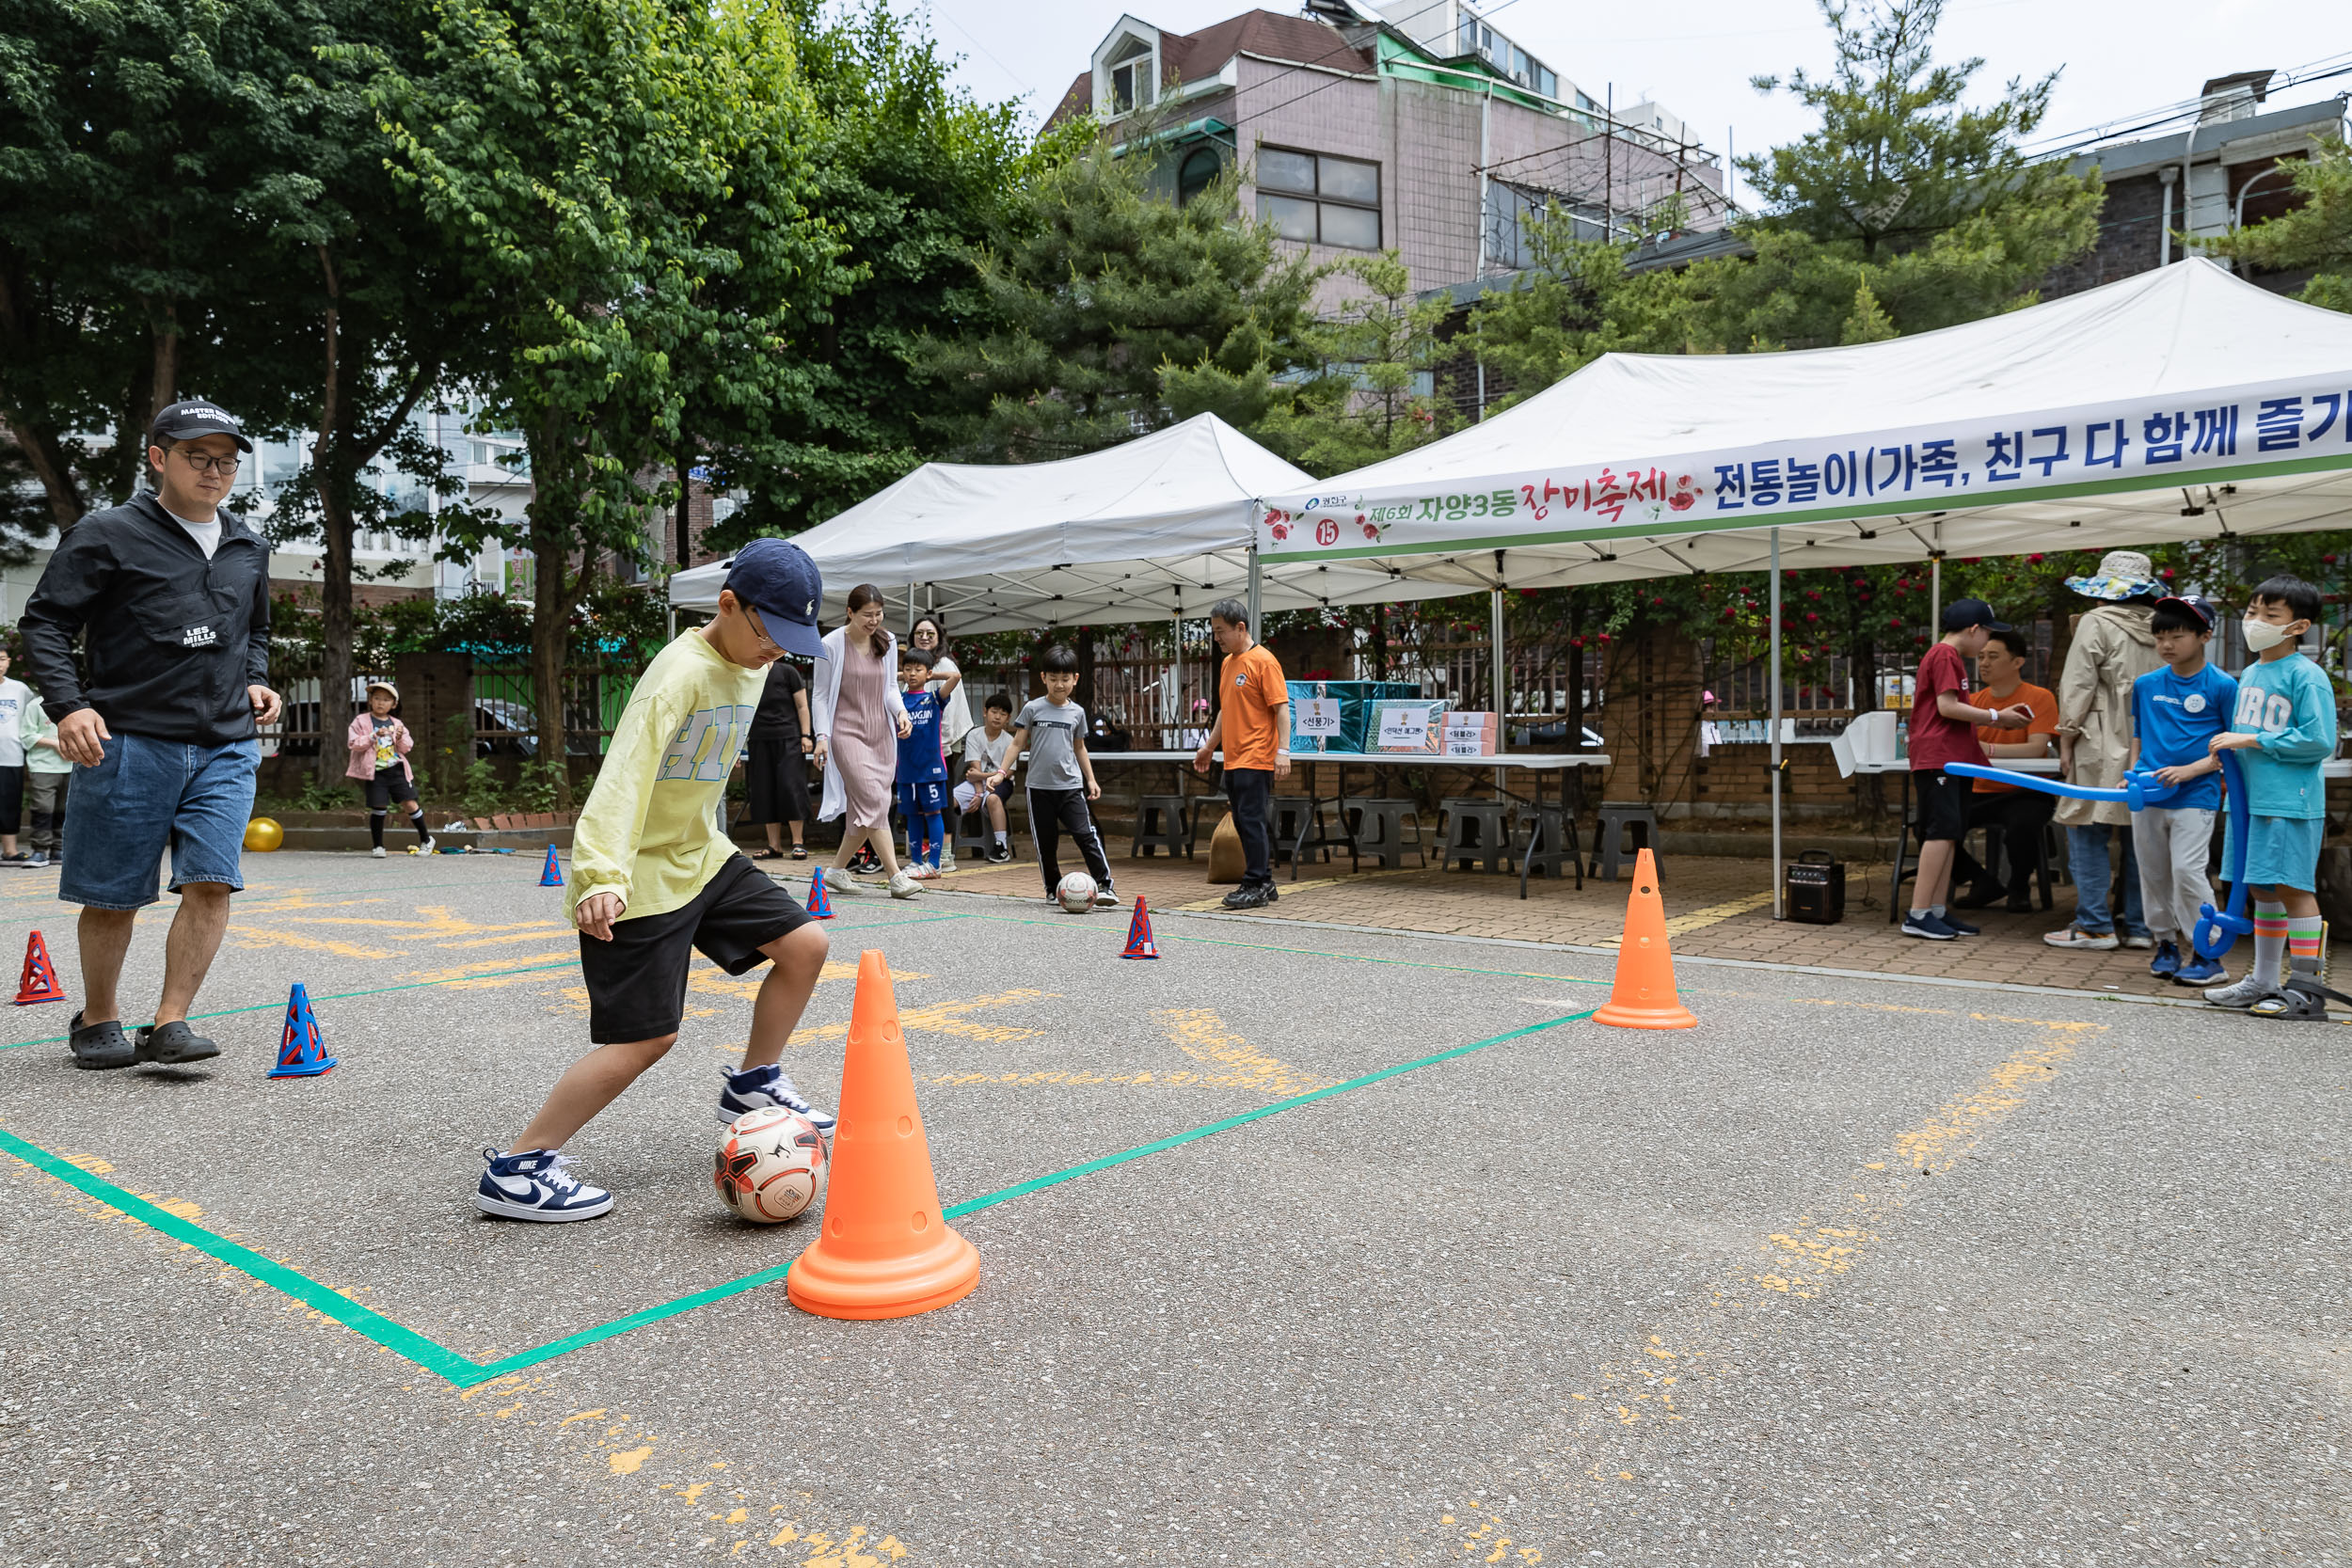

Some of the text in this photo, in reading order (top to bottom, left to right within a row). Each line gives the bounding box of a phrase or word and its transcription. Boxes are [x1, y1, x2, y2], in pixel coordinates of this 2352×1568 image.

[181, 407, 215, 416] MASTER
[197, 413, 229, 424] EDITION
[1369, 504, 1412, 523] 제6회
[1416, 489, 1518, 522] 자양3동
[1520, 467, 1667, 523] 장미축제
[1714, 438, 1970, 510] 전통놀이(가족,
[1985, 426, 2070, 483] 친구
[2085, 419, 2130, 468] 다
[2143, 404, 2238, 465] 함께
[1319, 520, 1336, 545] 15
[183, 631, 216, 644] MILLS
[186, 626, 209, 637] LES
[929, 784, 939, 799] 5
[517, 1160, 538, 1170] NIKE
